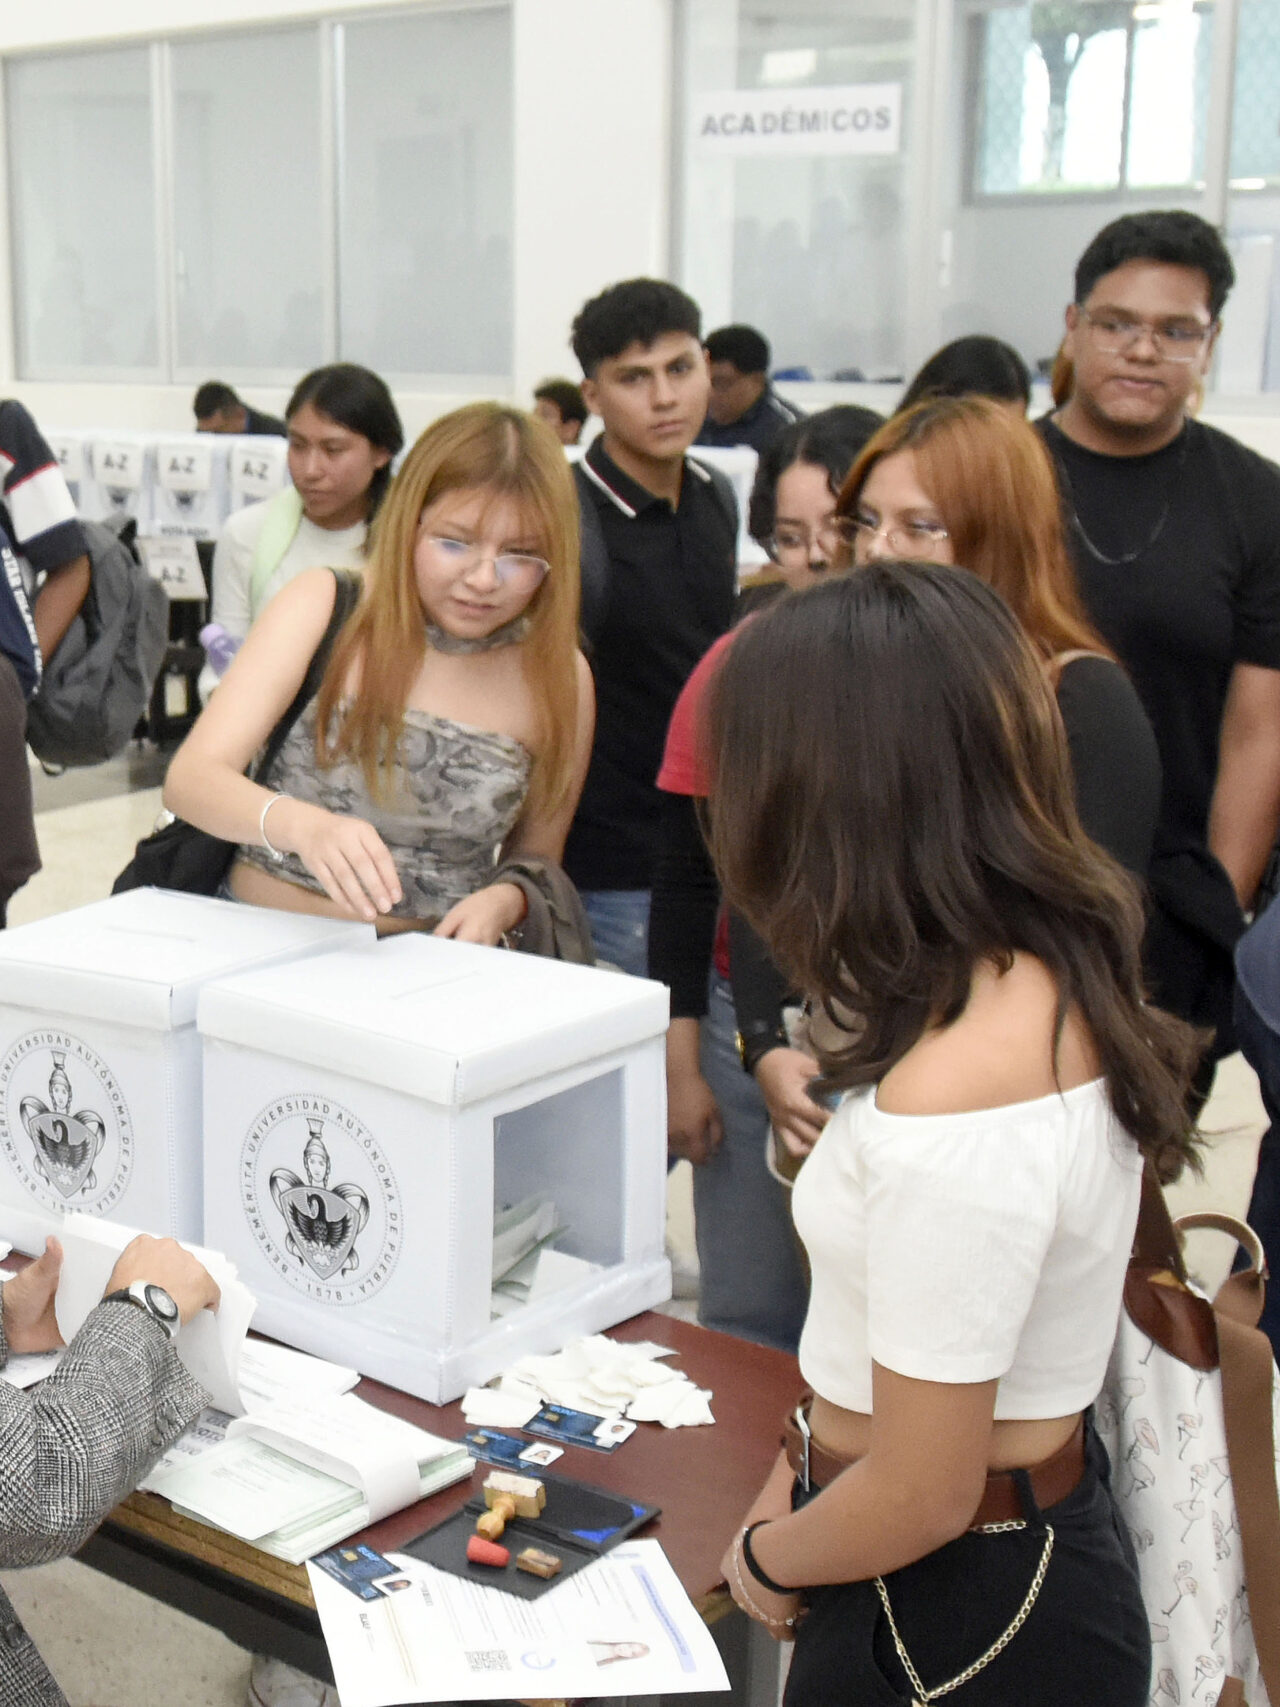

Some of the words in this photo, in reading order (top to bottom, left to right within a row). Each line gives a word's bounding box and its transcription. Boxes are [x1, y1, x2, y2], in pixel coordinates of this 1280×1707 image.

[700, 105, 891, 136] ACADÉMICOS
[1, 1034, 71, 1082] UNIVERSIDAD
[77, 1046, 127, 1127] AUTÓNOMA
[121, 1136, 130, 1157] DE
[249, 1100, 330, 1152] UNIVERSIDAD
[337, 1112, 395, 1201] AUTÓNOMA
[96, 1164, 128, 1212] PUEBLA
[243, 1161, 287, 1273] BENEMÉRITA
[388, 1213, 399, 1233] DE
[306, 1284, 343, 1300] 1578
[360, 1244, 396, 1293] PUEBLA
